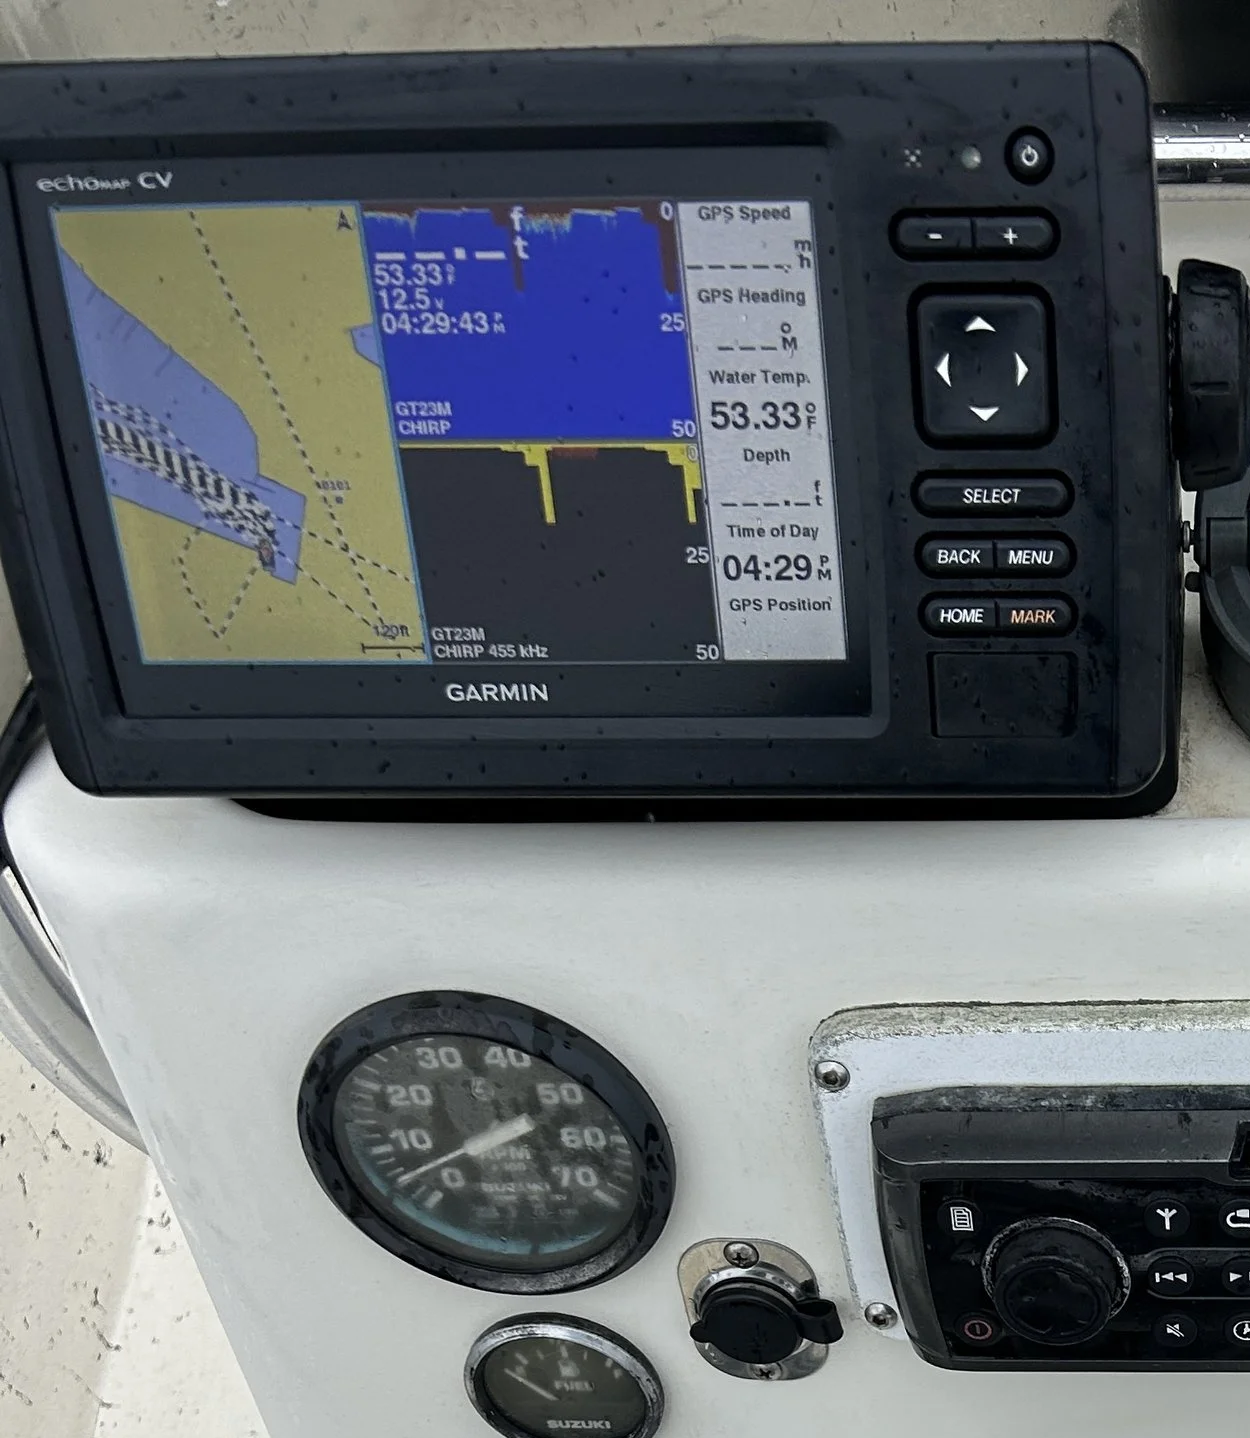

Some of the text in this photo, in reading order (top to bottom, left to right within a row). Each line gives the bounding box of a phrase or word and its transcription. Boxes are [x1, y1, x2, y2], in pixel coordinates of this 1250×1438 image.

[137, 172, 173, 189] CV
[660, 202, 673, 220] 0
[698, 206, 791, 223] GPS Speed
[374, 263, 443, 285] 53.33
[379, 288, 431, 310] 12.5
[697, 288, 806, 306] GPS Heading
[382, 312, 489, 334] 04:29:43
[660, 313, 685, 332] 25
[709, 370, 756, 384] Water
[395, 400, 452, 416] GT23M
[711, 401, 801, 430] 53.33
[399, 420, 451, 434] CHIRP
[672, 419, 696, 437] 50
[743, 448, 791, 465] Depth
[962, 488, 1021, 503] SELECT
[726, 524, 819, 540] Time of Day
[686, 547, 709, 564] 25
[937, 549, 981, 564] BACK
[1008, 550, 1053, 565] MENU
[723, 554, 812, 581] 04:29
[729, 597, 831, 611] GPS Position
[939, 608, 984, 623] HOME
[1011, 609, 1056, 624] MARK
[431, 627, 486, 641] GT23M
[434, 643, 549, 658] CHIRP 455 kHz
[696, 643, 719, 660] 50
[446, 683, 549, 701] GARMIN
[415, 1046, 463, 1069] 30
[484, 1046, 532, 1068] 40
[385, 1084, 433, 1107] 20
[536, 1082, 584, 1105] 50
[388, 1127, 433, 1151] 10
[560, 1126, 607, 1151] 60
[441, 1166, 465, 1189] 0
[551, 1165, 599, 1187] 70
[546, 1420, 611, 1429] SUZUKI
